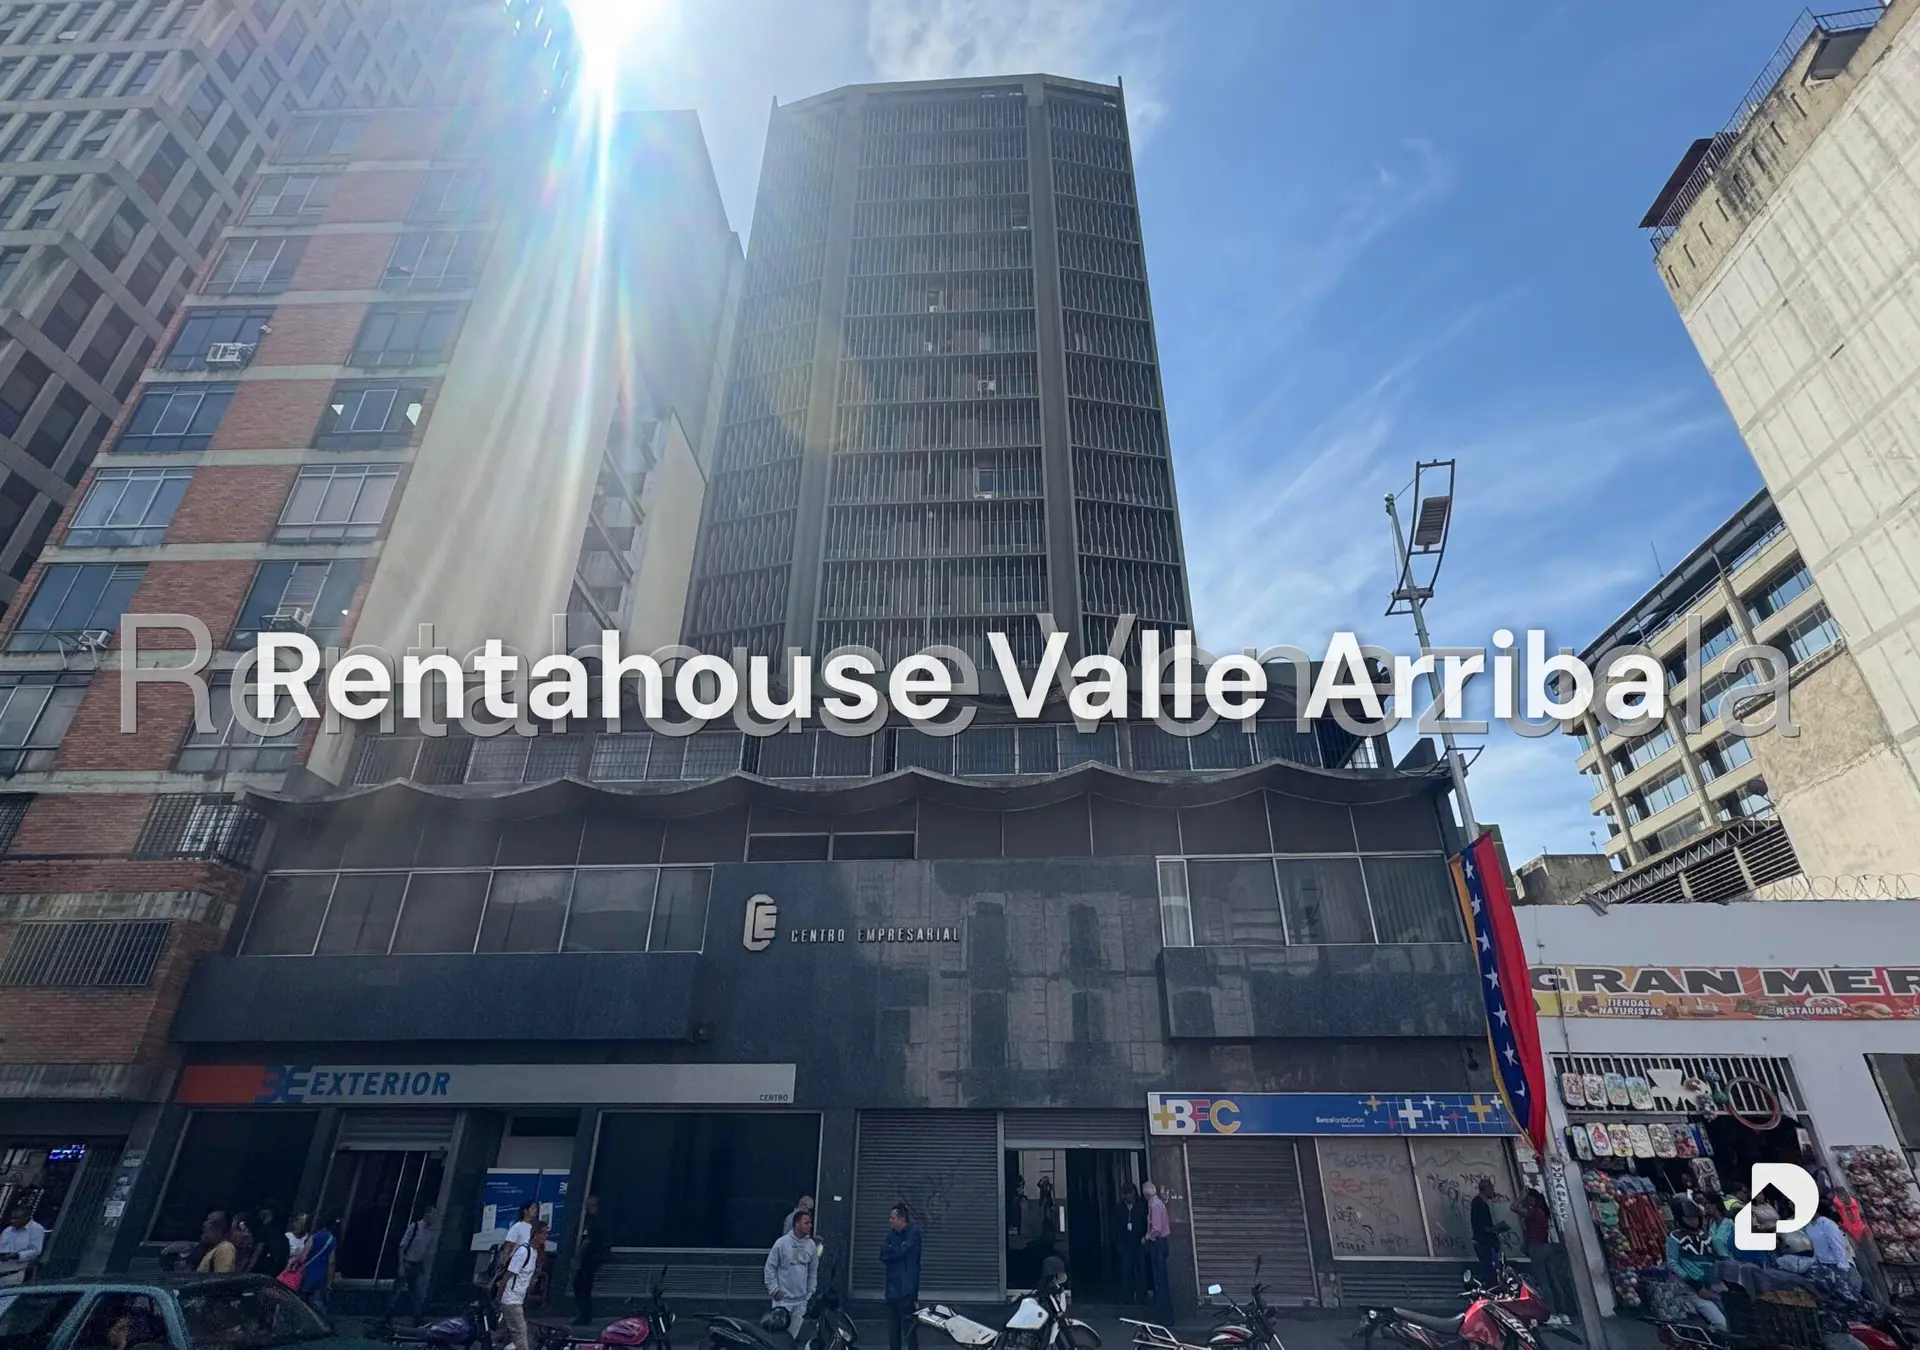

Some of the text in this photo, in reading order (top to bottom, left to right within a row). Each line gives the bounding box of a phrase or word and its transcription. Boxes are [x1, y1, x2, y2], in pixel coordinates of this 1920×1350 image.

[791, 927, 960, 942] CENTRO EMPRESARIAL
[1528, 965, 1745, 997] GRAN
[1607, 998, 1651, 1007] TIENDAS
[1599, 1007, 1663, 1016] NATURISTAS
[1776, 1007, 1844, 1015] RESTAURANT
[310, 1071, 451, 1096] EXTERIOR
[759, 1094, 789, 1102] CENTRO
